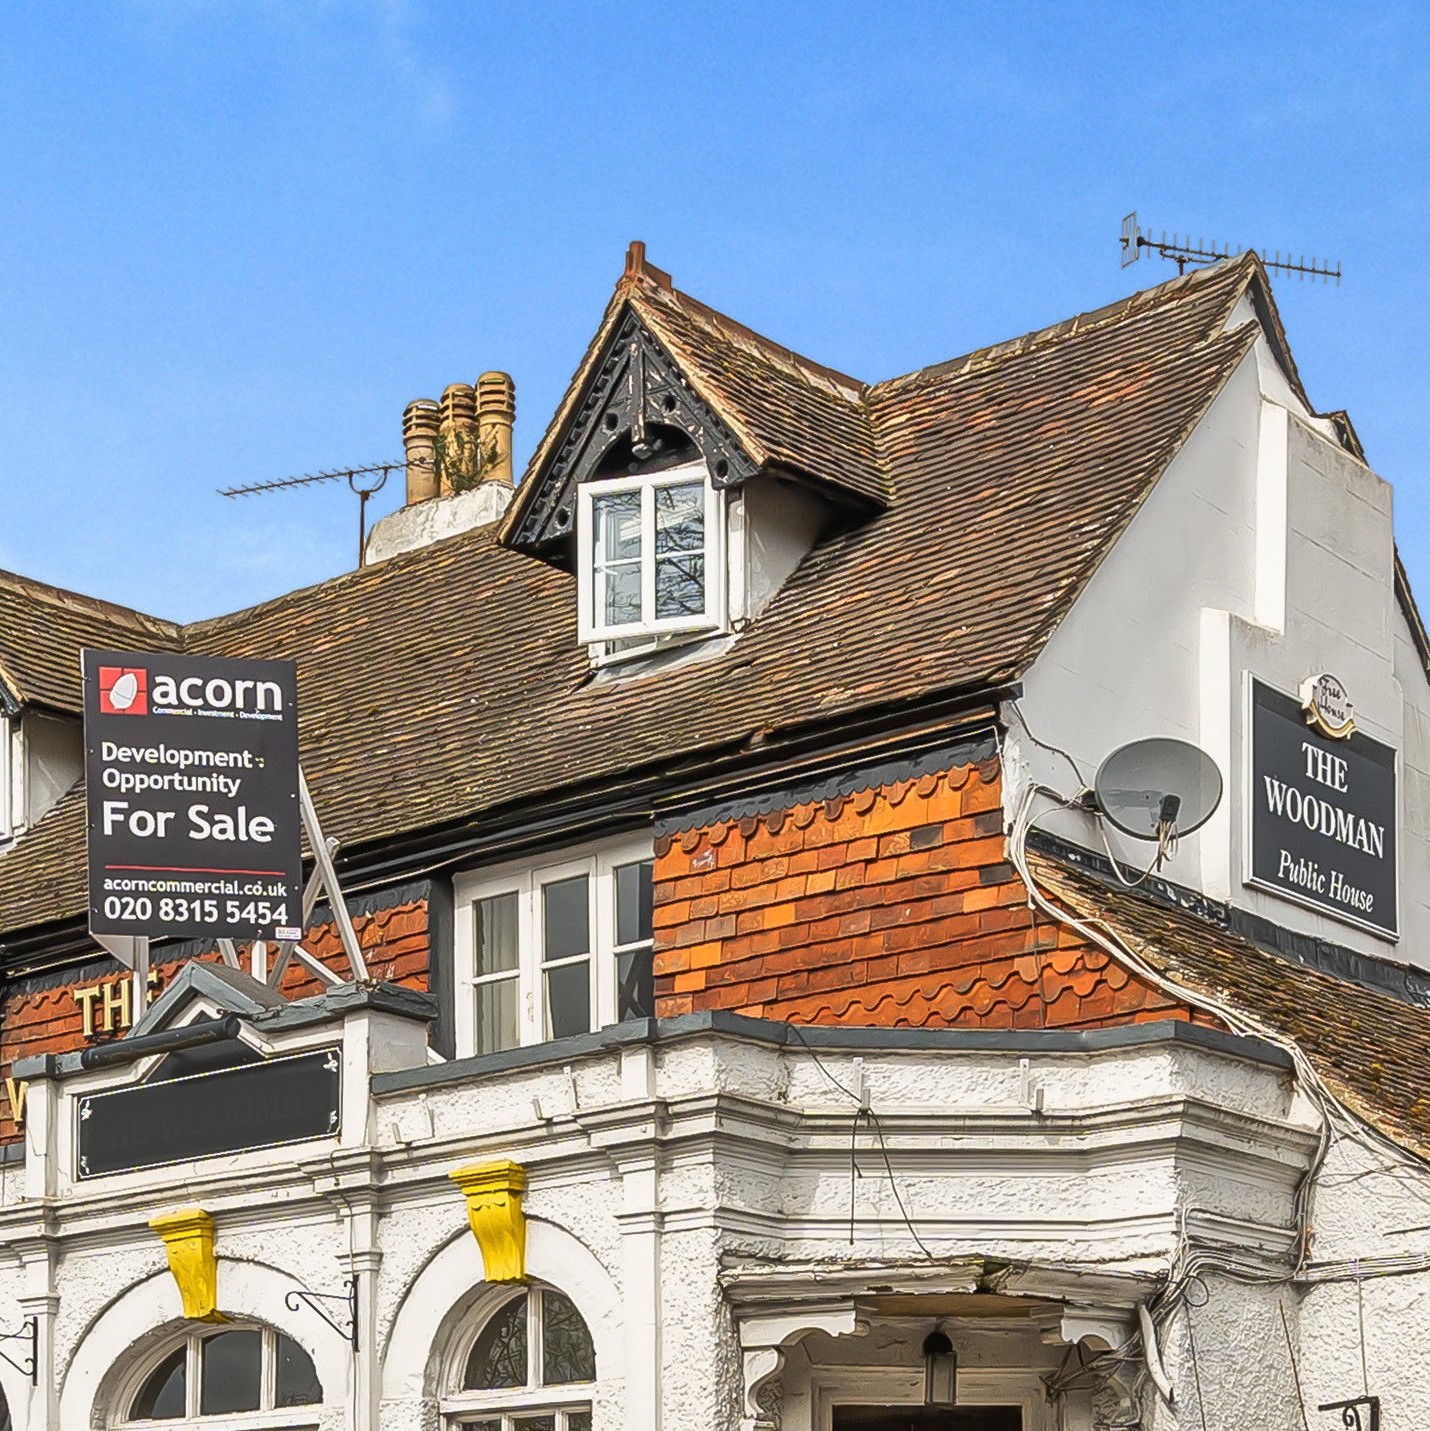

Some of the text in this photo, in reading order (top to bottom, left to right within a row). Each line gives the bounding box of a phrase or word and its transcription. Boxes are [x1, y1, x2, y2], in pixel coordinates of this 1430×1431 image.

[152, 675, 282, 711] acorn
[240, 711, 282, 721] Development
[101, 742, 253, 770] Development
[1302, 742, 1348, 793] THE
[102, 768, 241, 797] Opportunity
[103, 801, 274, 842] For Sale
[1264, 776, 1385, 859] WOODMAN
[103, 877, 287, 897] acorncommercial.co.uk
[1278, 849, 1374, 913] Public House
[104, 897, 288, 926] 020 8315 5454
